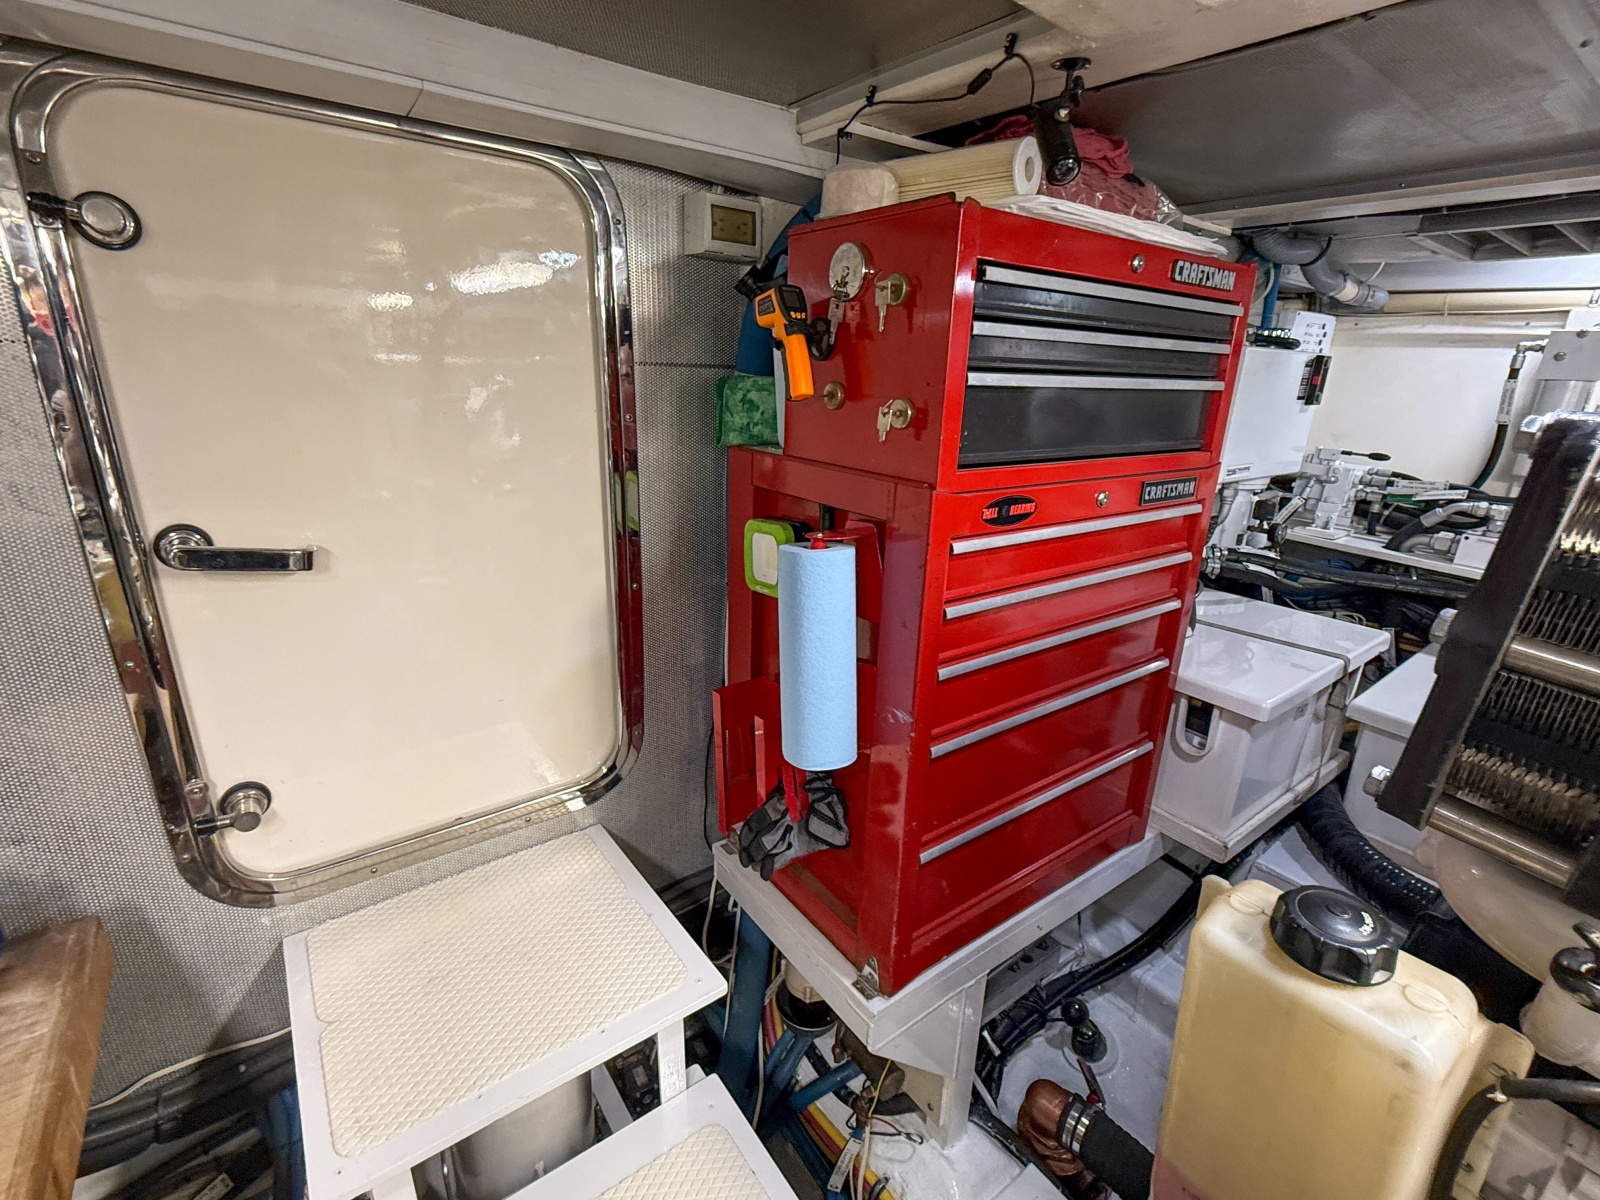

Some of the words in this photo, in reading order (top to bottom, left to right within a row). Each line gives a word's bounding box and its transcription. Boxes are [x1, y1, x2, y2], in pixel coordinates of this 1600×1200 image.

[1174, 260, 1237, 291] CRAFTSMAN
[1144, 481, 1196, 500] CRAFTSMAN
[1009, 502, 1036, 516] BEARING
